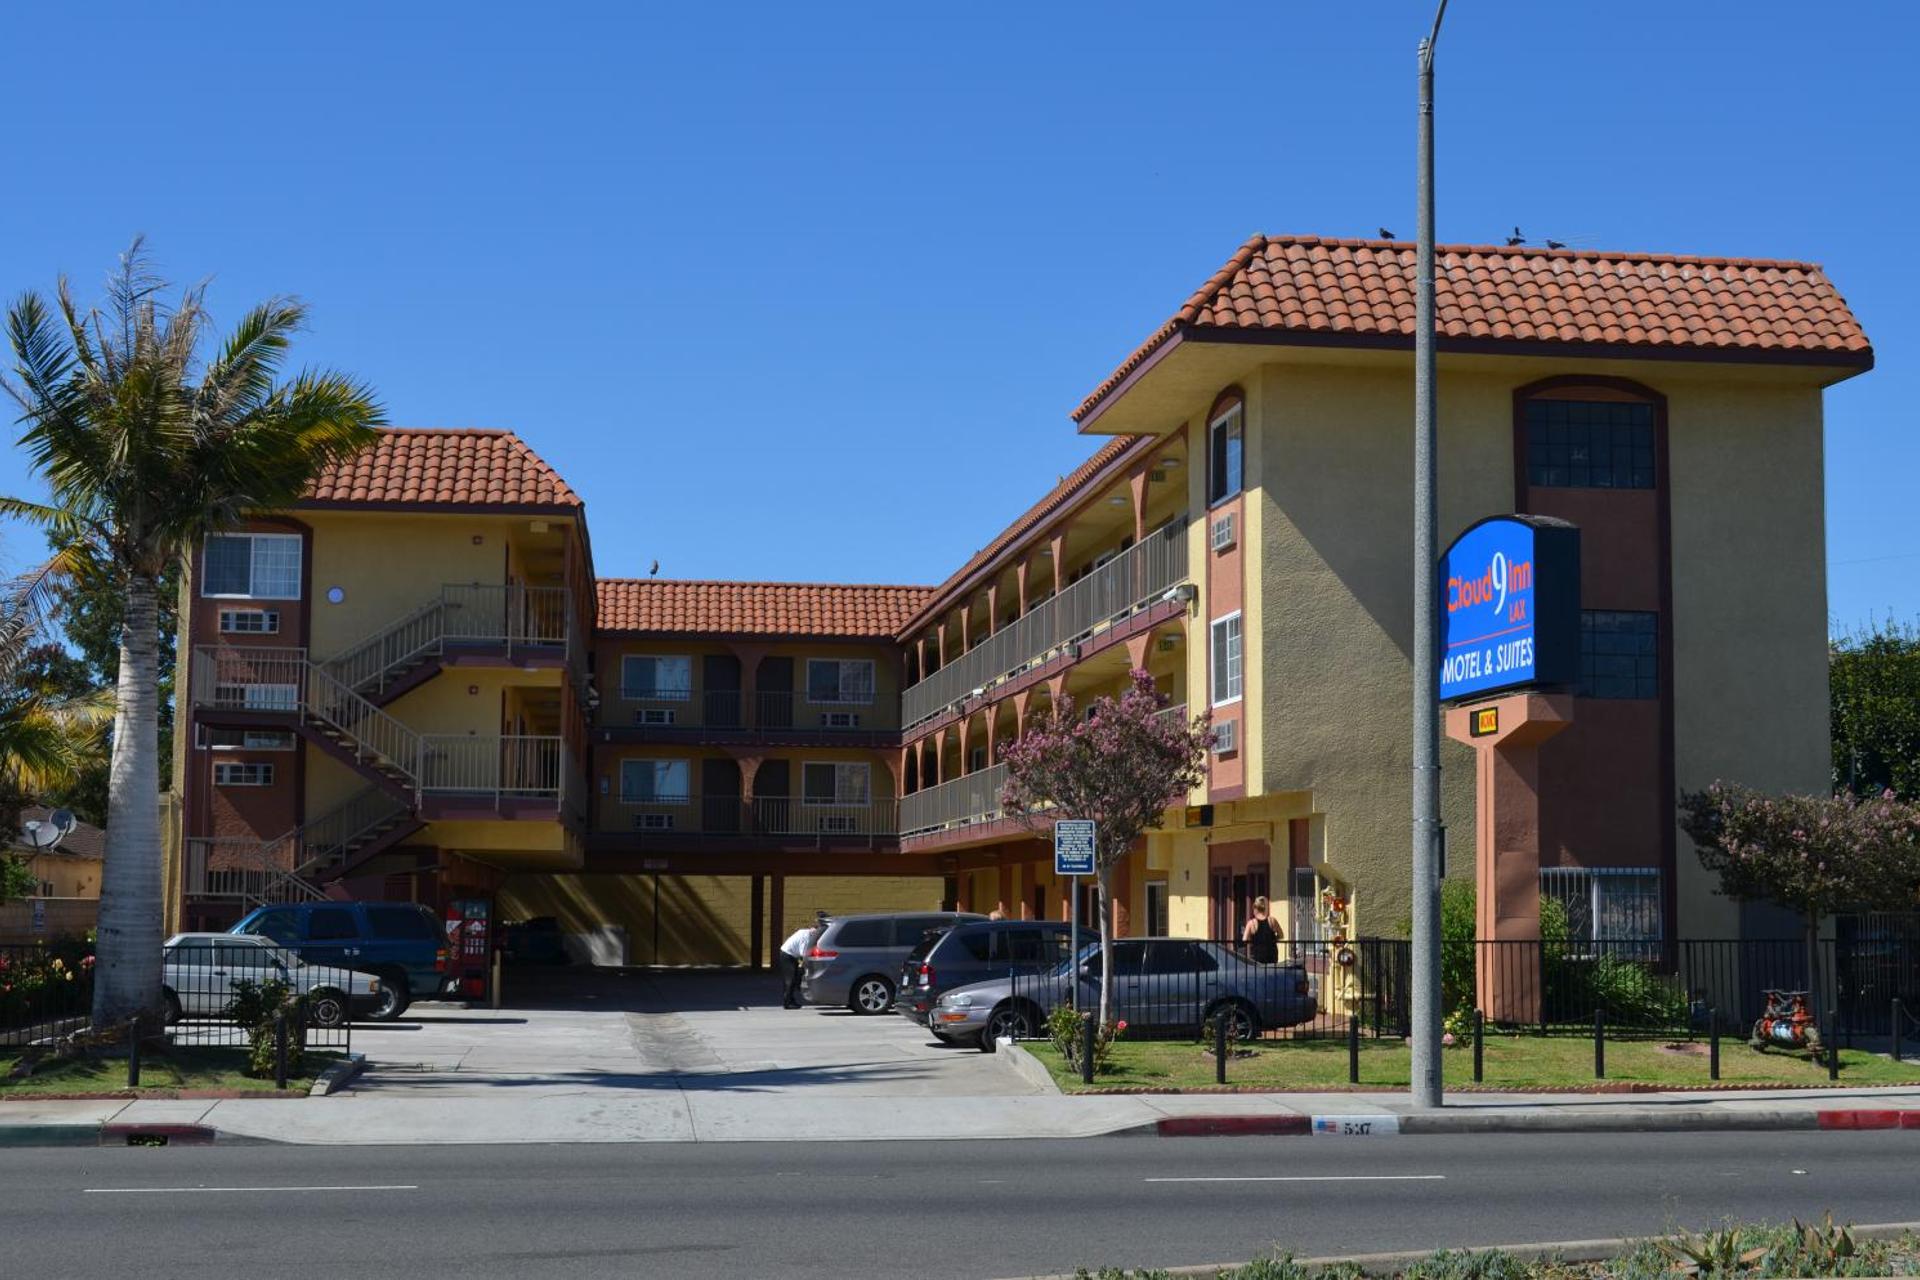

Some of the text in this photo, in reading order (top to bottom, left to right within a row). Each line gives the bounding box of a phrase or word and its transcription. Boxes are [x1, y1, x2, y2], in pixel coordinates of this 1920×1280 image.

[1446, 551, 1531, 616] Cloud 9 Inn
[1509, 598, 1525, 624] LAX
[1443, 636, 1533, 685] MOTEL & SUITES
